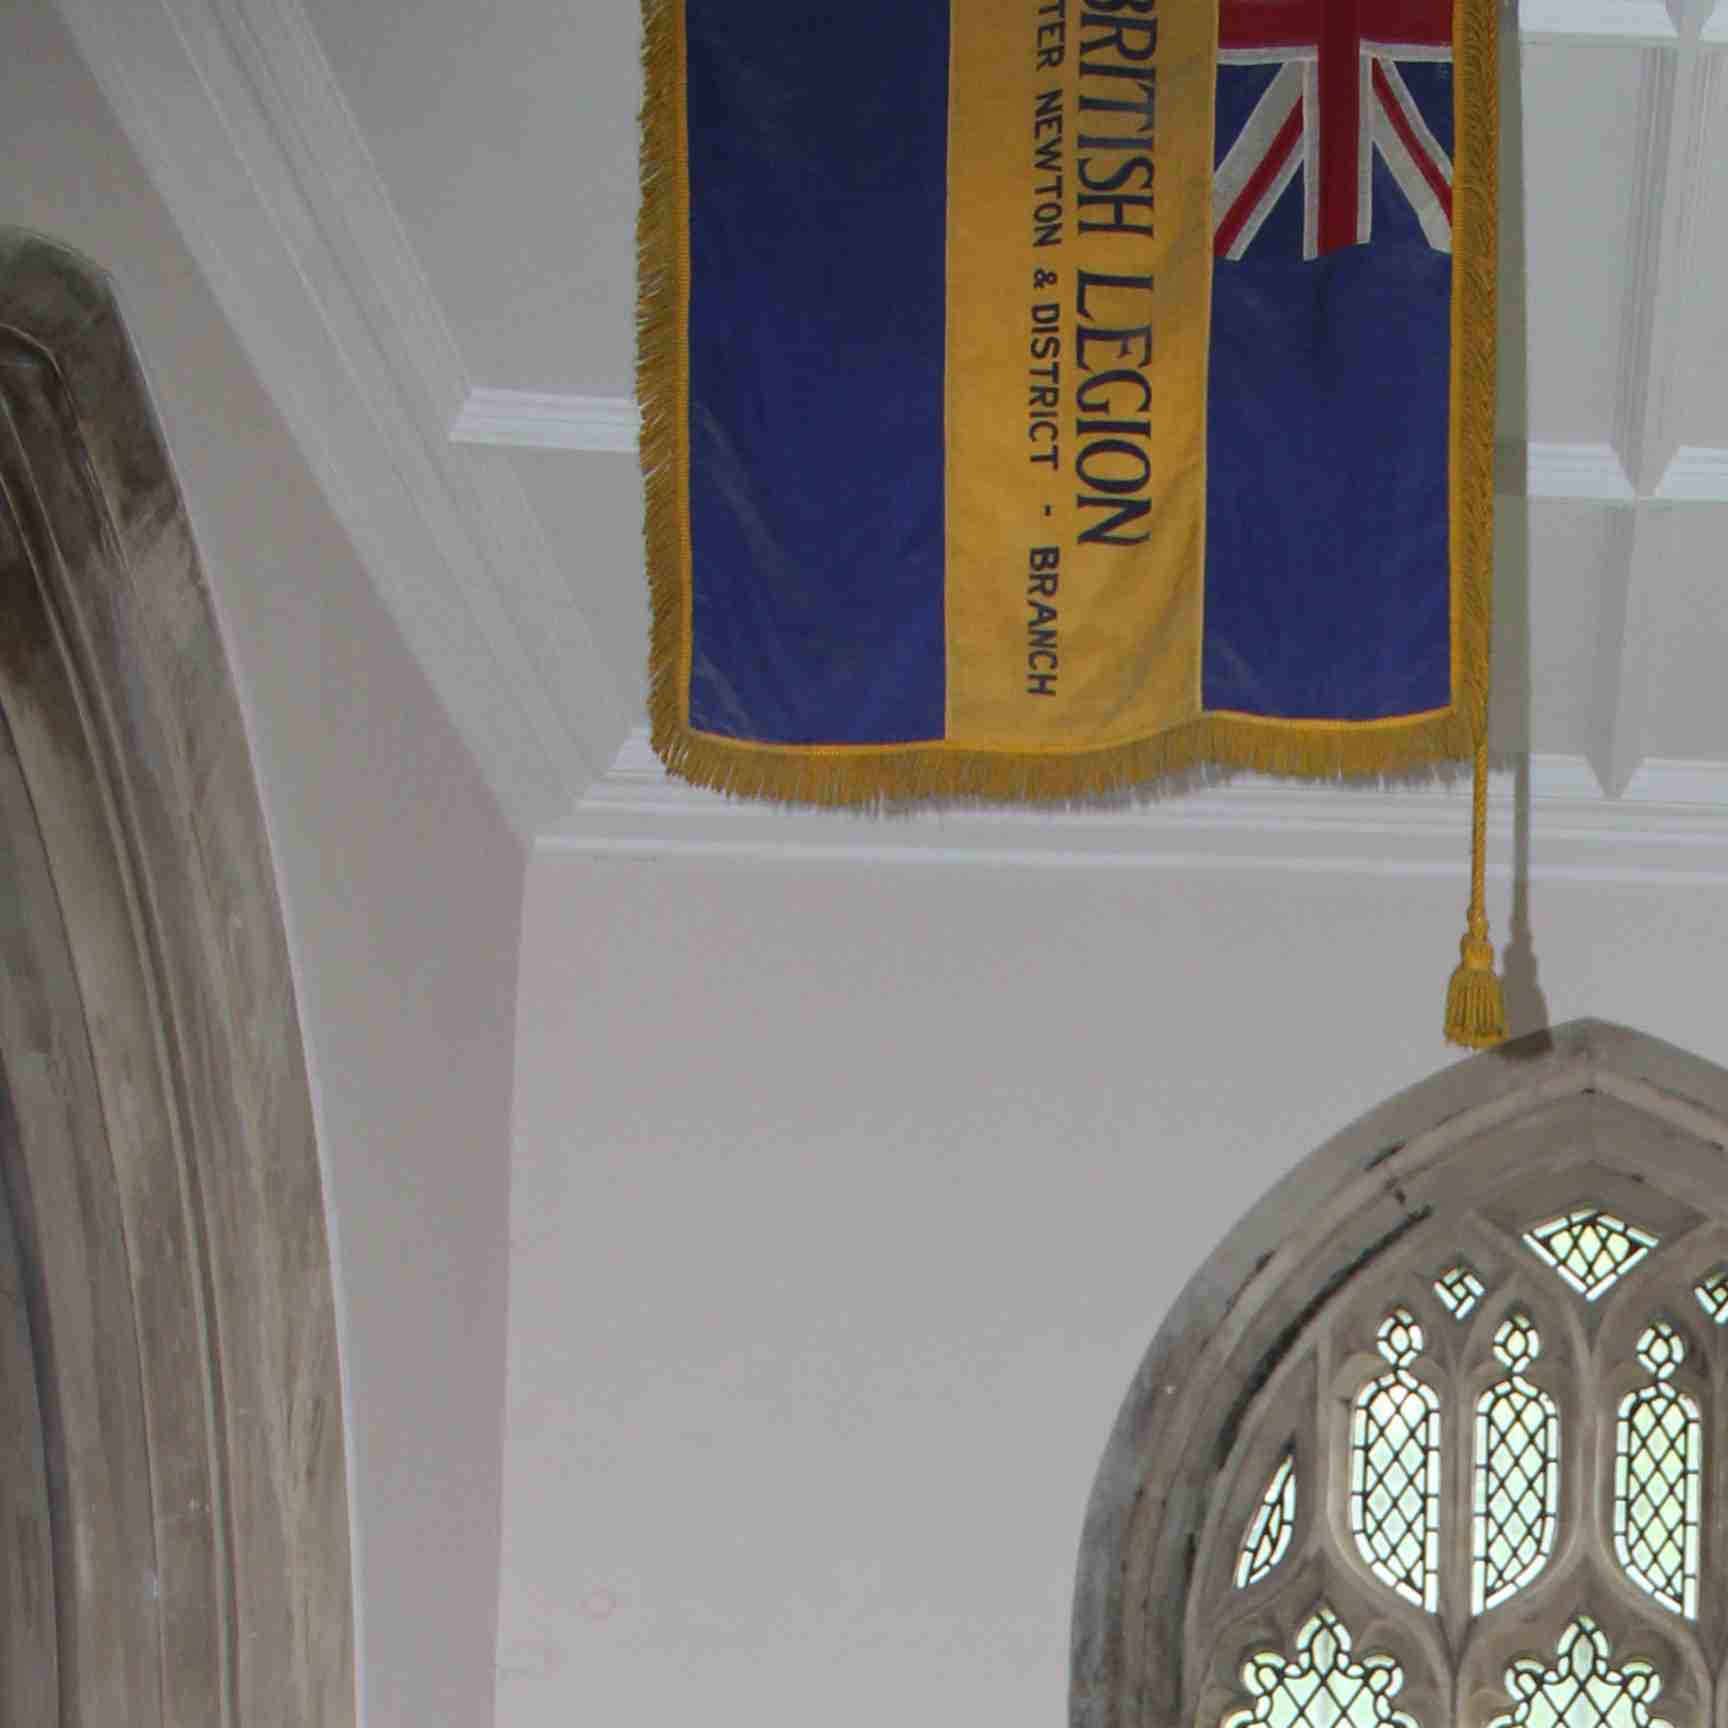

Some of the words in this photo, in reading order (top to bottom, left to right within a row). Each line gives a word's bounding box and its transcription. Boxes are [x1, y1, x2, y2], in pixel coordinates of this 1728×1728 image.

[1033, 88, 1064, 248] NEWTON
[1076, 0, 1158, 240] RITISH
[1033, 268, 1058, 289] &
[1029, 302, 1061, 470] DISTRICT
[1075, 269, 1154, 545] LEGION
[1026, 545, 1061, 697] BRANCH
